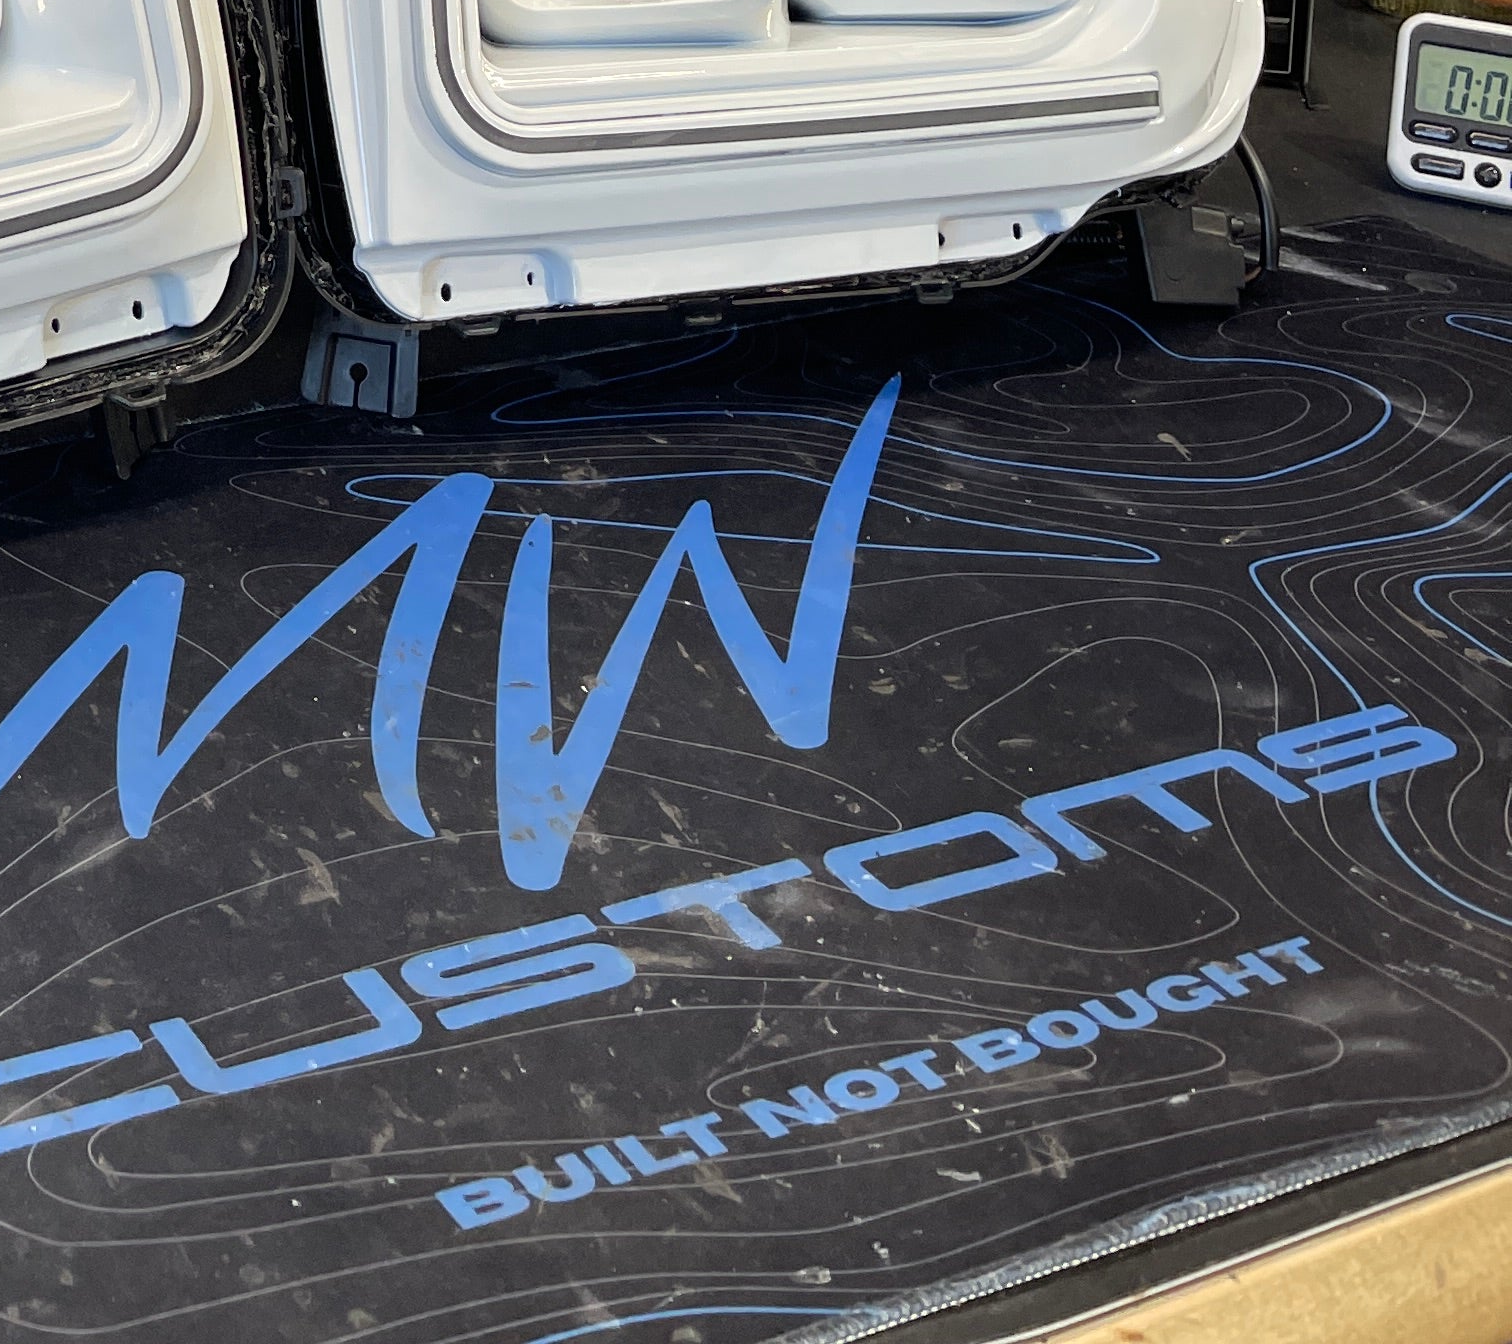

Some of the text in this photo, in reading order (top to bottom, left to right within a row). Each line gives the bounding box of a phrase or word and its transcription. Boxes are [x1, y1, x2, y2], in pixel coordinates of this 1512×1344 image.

[1444, 65, 1512, 121] 0:0
[435, 935, 1325, 1232] BUILT NOT BOUGHT
